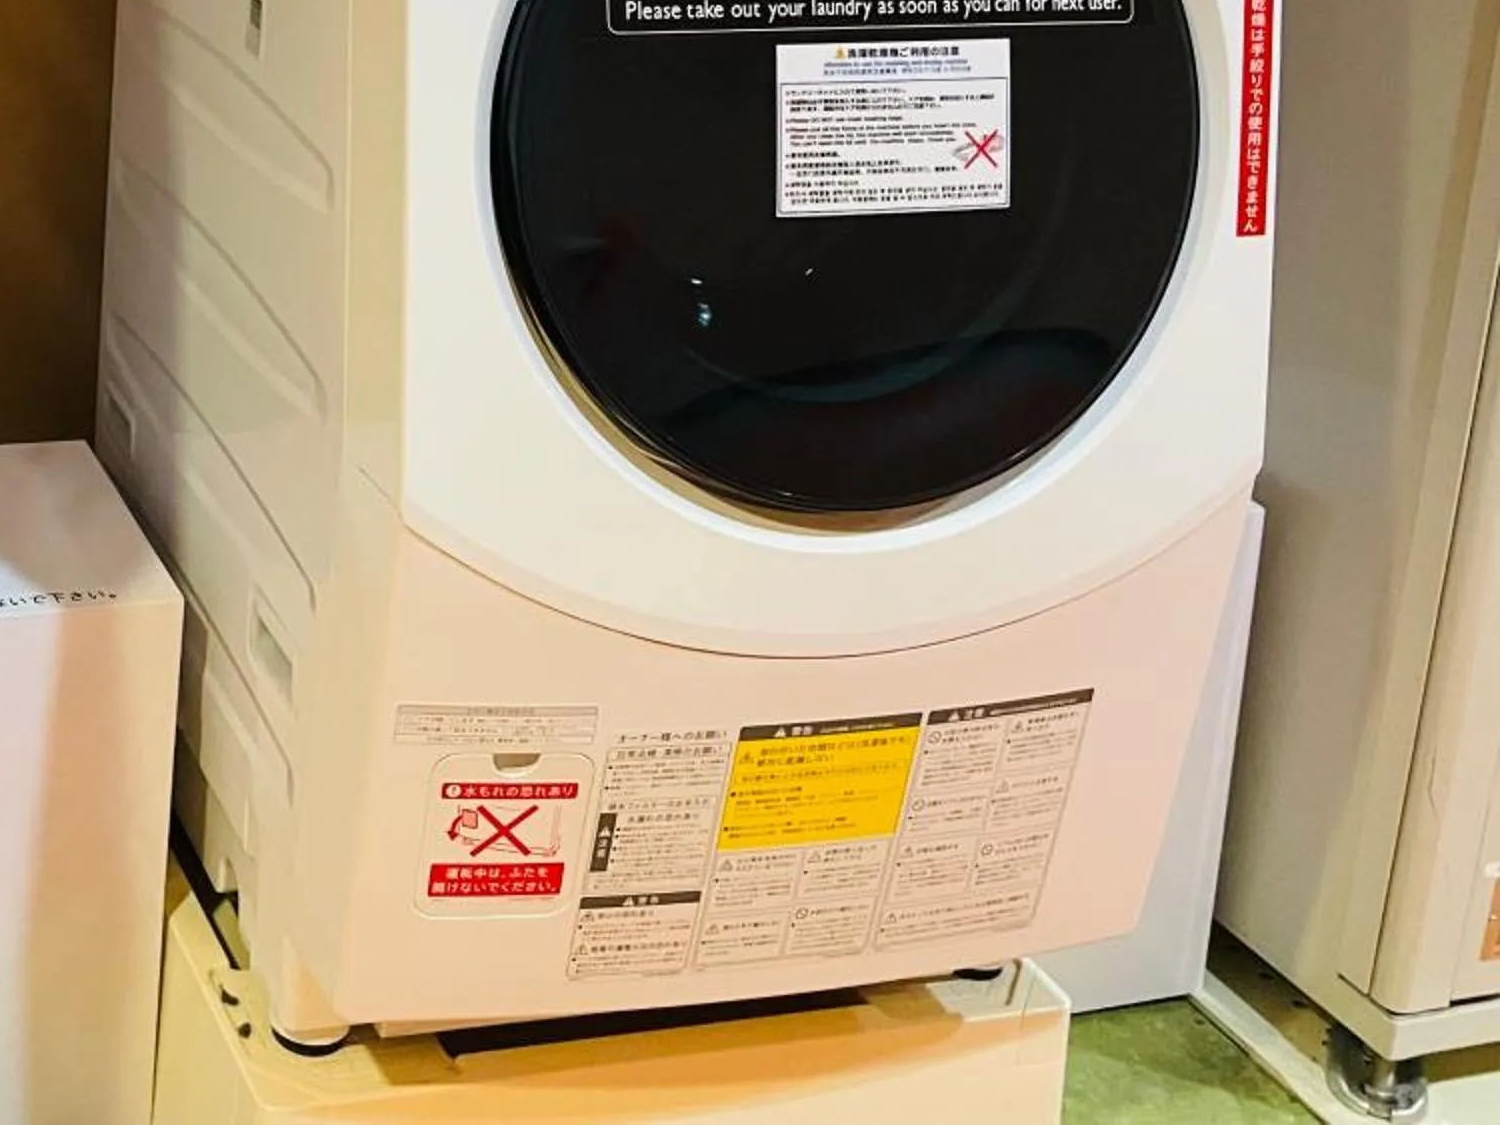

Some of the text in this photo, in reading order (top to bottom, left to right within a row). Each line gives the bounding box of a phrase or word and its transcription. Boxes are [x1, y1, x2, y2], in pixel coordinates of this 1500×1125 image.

[626, 0, 682, 20] Please
[687, 0, 725, 19] take
[731, 2, 761, 17] out
[768, 2, 806, 23] your
[877, 0, 894, 13] as
[899, 0, 937, 13] soon
